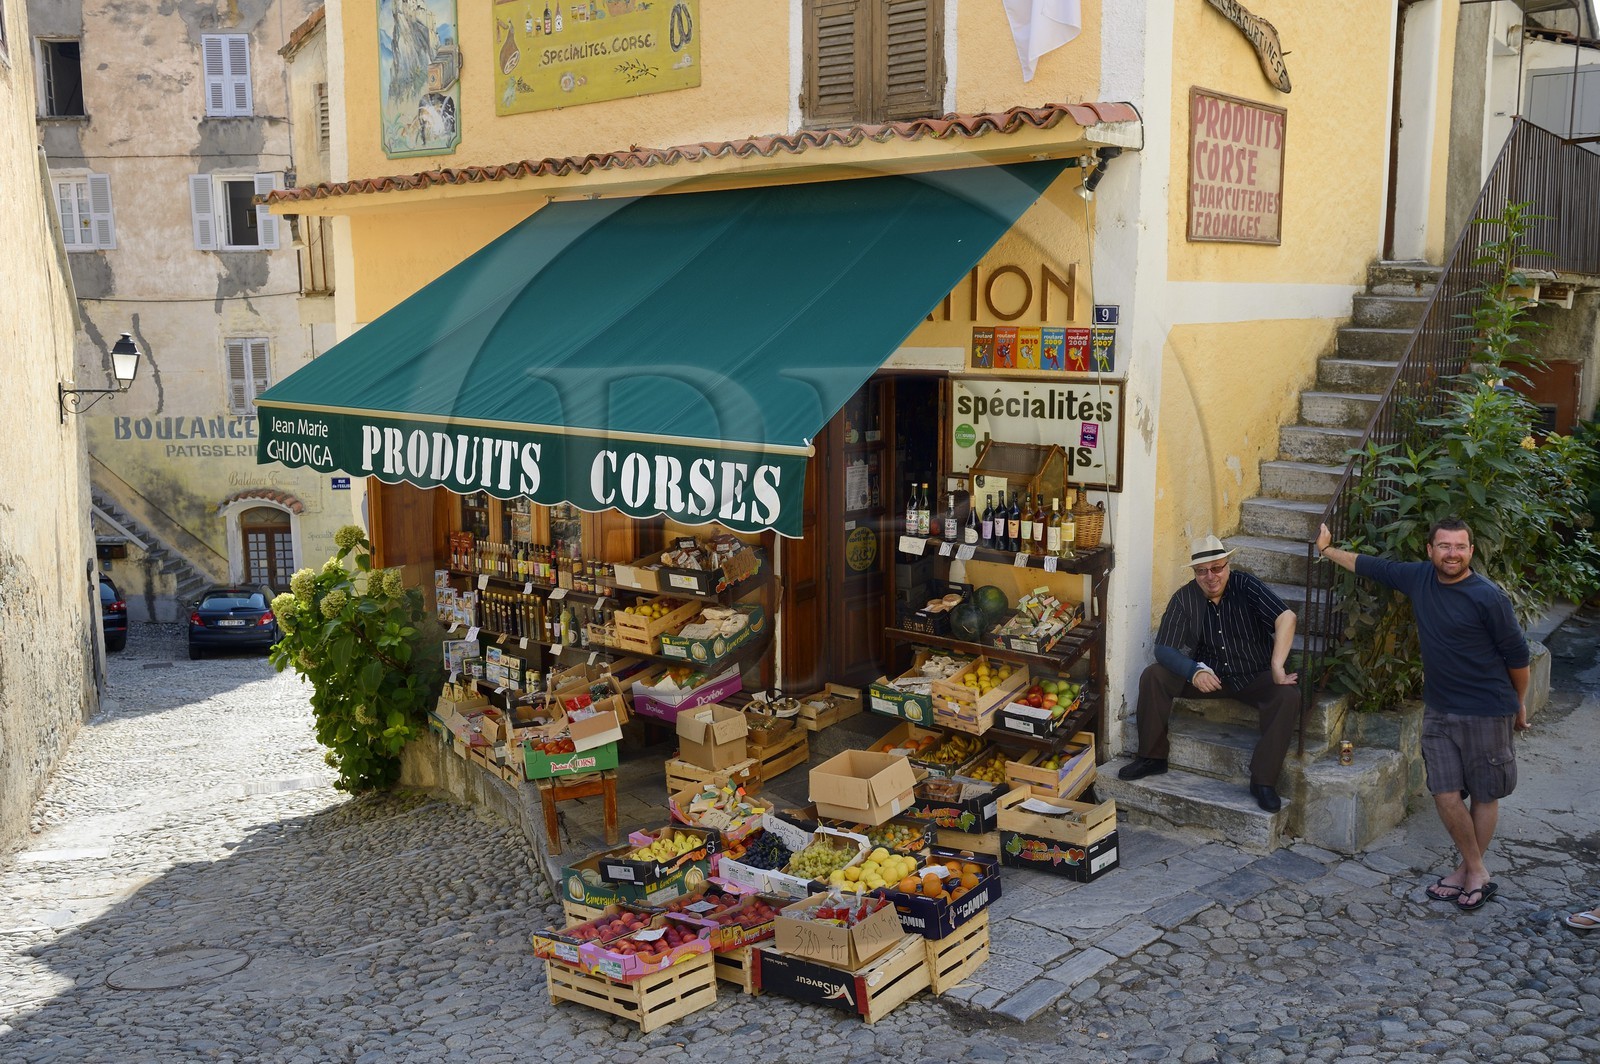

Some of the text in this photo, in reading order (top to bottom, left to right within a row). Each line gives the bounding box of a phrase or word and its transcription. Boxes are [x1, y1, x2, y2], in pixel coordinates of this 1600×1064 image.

[1194, 95, 1284, 150] PRODUITS
[1195, 140, 1259, 187] CORSE
[1191, 182, 1280, 214] CHARCUTERIES
[1194, 211, 1261, 238] FROMAGES
[1102, 308, 1109, 321] 9
[957, 387, 1113, 425] spécialités
[271, 416, 329, 438] Jean Marie
[361, 424, 542, 495] PRODUITS
[590, 449, 782, 526] CORSES
[956, 888, 989, 919] LE GAMIN
